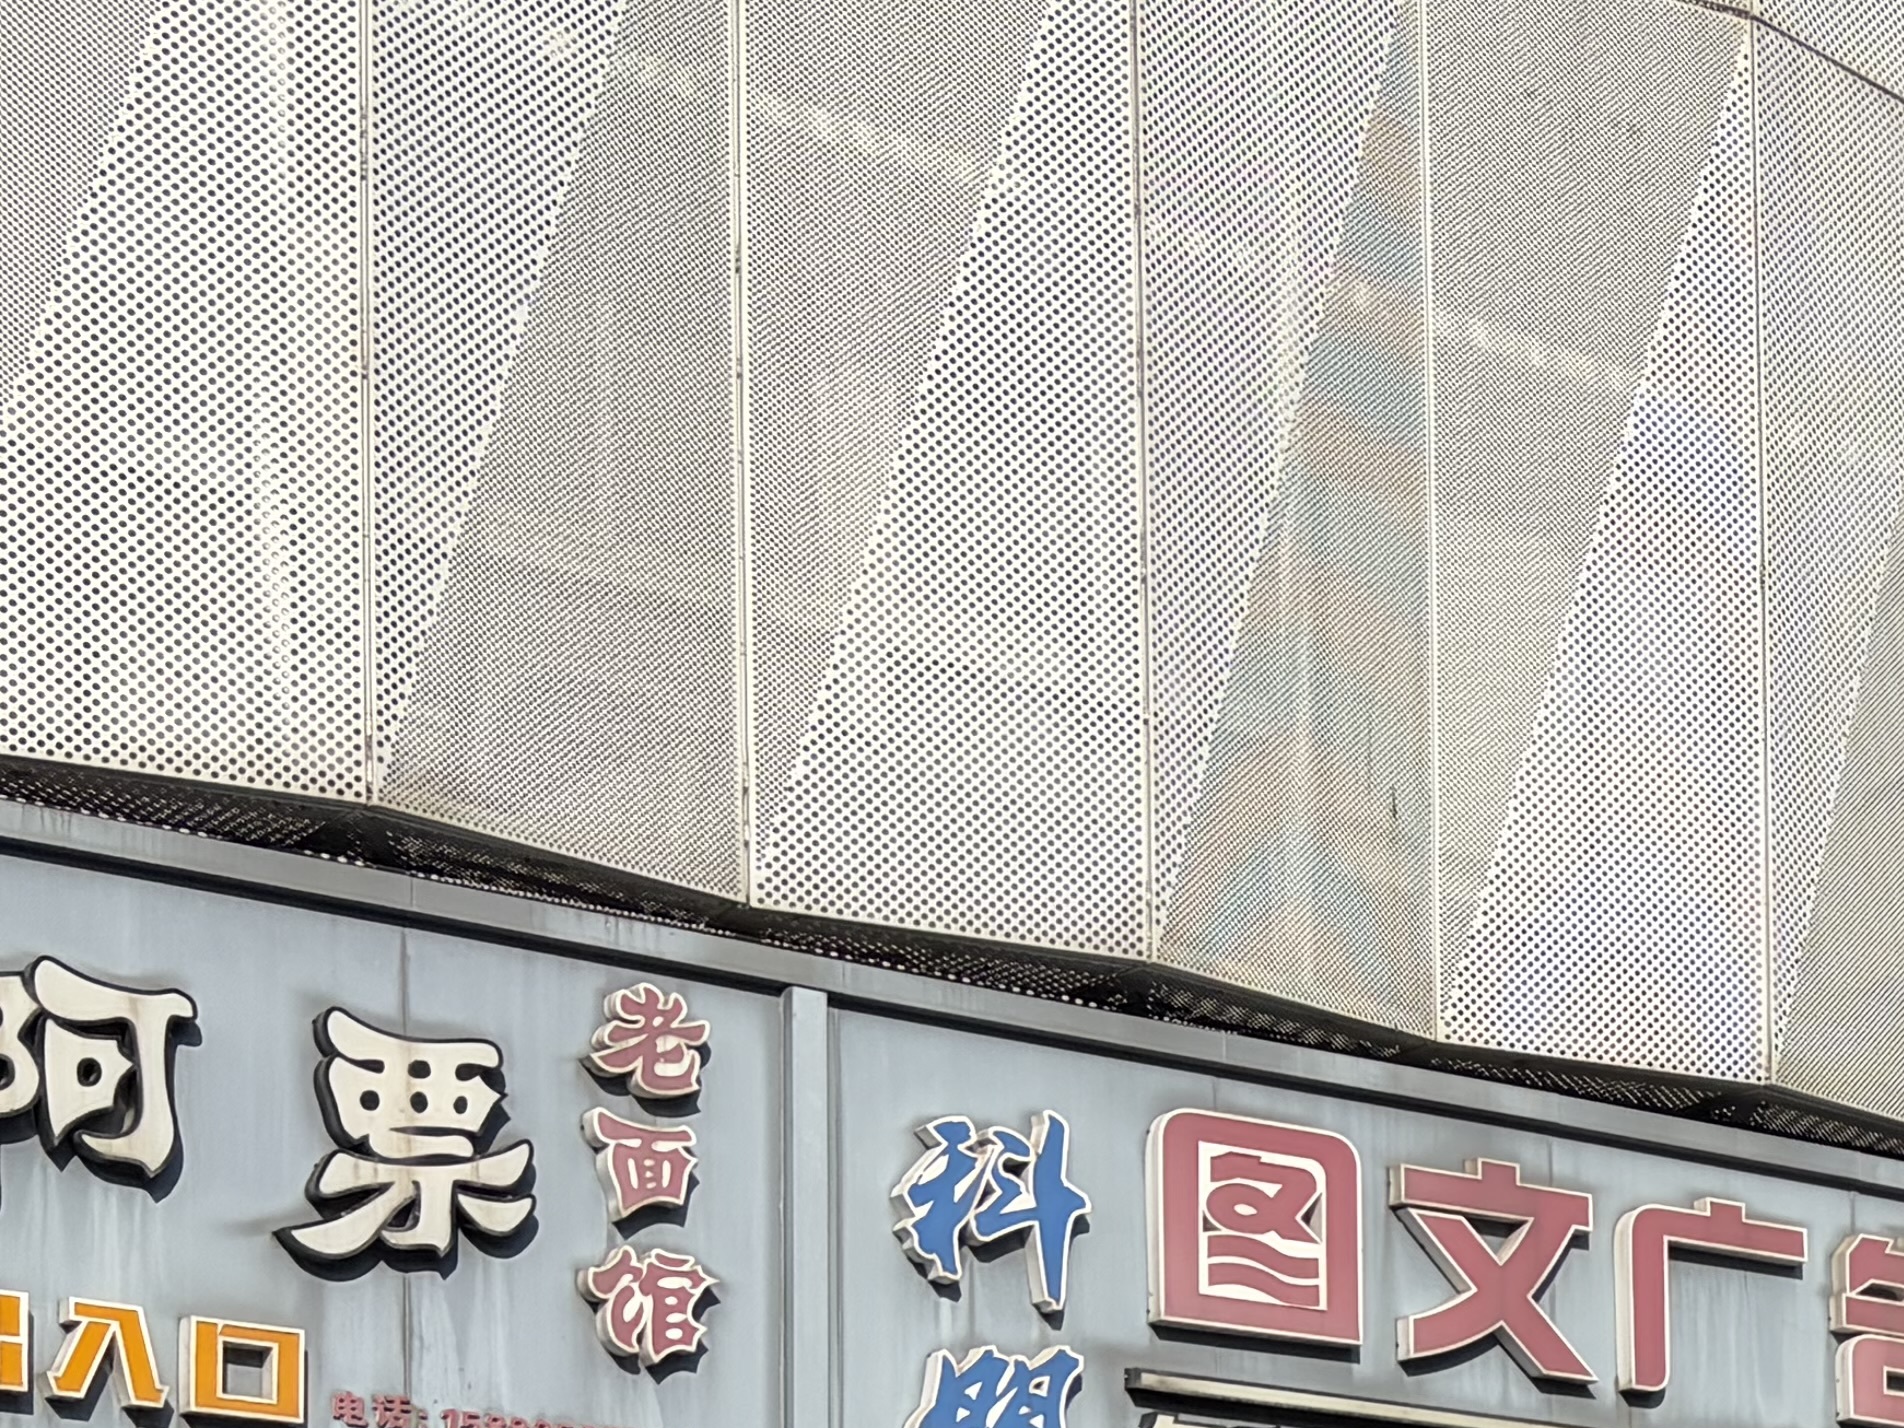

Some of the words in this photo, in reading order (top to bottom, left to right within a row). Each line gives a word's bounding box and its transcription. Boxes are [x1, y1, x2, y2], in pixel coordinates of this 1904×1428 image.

[582, 983, 717, 1372] 老面馆
[0, 1290, 307, 1425] 入口
